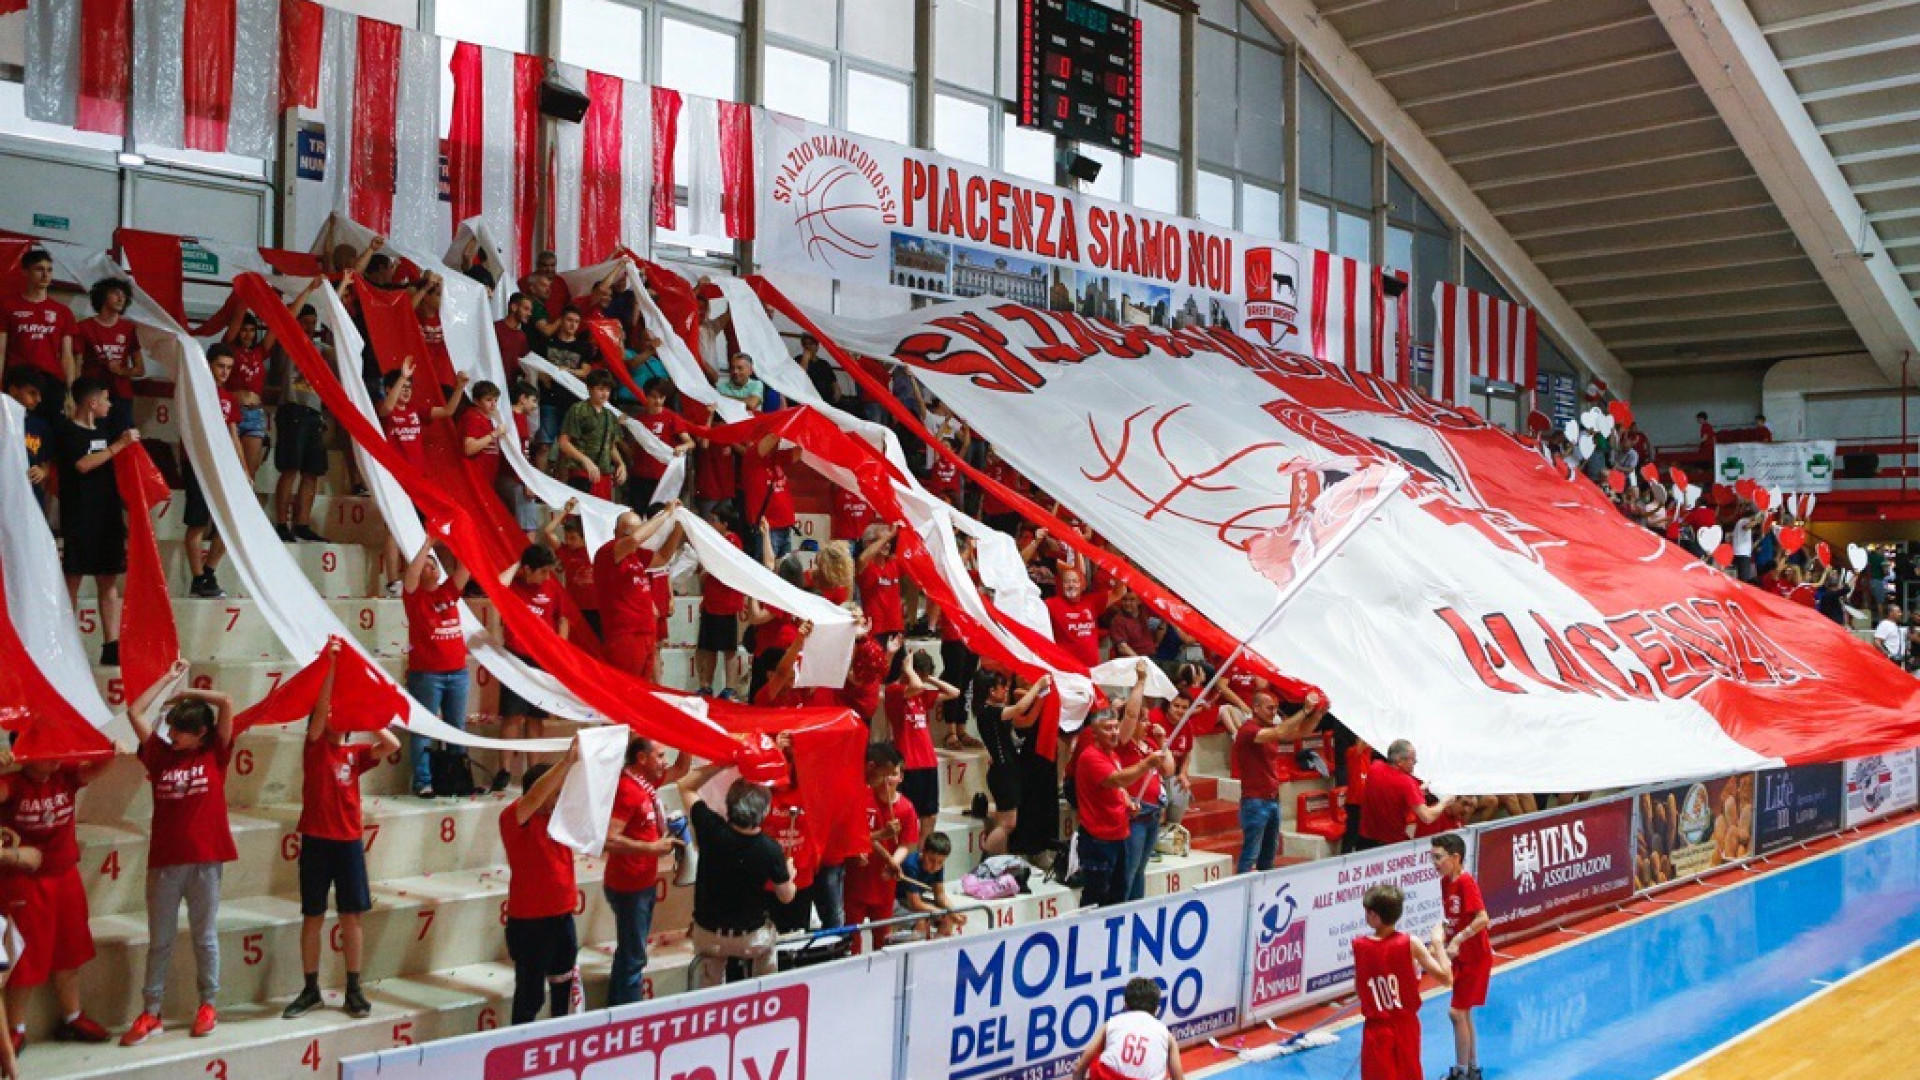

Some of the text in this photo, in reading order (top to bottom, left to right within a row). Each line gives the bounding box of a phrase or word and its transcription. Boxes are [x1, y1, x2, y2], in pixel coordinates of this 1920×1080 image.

[774, 134, 897, 224] SPAZIO BIANCOROSSO
[902, 157, 1234, 295] PIACENZA SIAMO NOI
[1246, 303, 1271, 318] BAKERY
[156, 404, 170, 425] 8
[337, 503, 365, 525] 10
[321, 552, 337, 573] 9
[79, 608, 96, 632] 5
[225, 608, 241, 632] 7
[359, 608, 375, 630] 9
[108, 677, 124, 705] 5
[235, 750, 254, 776] 6
[946, 762, 968, 785] 17
[440, 817, 456, 843] 8
[1539, 820, 1588, 868] ITAS
[101, 850, 121, 881] 4
[1338, 870, 1350, 886] DA
[1352, 866, 1362, 882] 25
[1365, 860, 1385, 879] ANNI
[1386, 853, 1417, 873] SEMPRE
[1542, 854, 1612, 890] ASSICURAZIONI
[1165, 872, 1181, 894] 18
[1038, 897, 1058, 919] 15
[1312, 892, 1334, 910] ALLE
[417, 910, 435, 941] 7
[996, 906, 1014, 927] 14
[243, 934, 264, 965] 5
[953, 899, 1210, 1016] MOLINO
[1257, 940, 1302, 972] GIOIA
[1254, 974, 1300, 1002] ANIMALI
[1367, 973, 1402, 1011] 109
[522, 996, 782, 1073] ETICHETTIFICIO
[950, 1015, 1015, 1066] DEL
[1168, 1012, 1234, 1041] industriali.it
[302, 1039, 322, 1072] 4
[1120, 1033, 1150, 1068] 65
